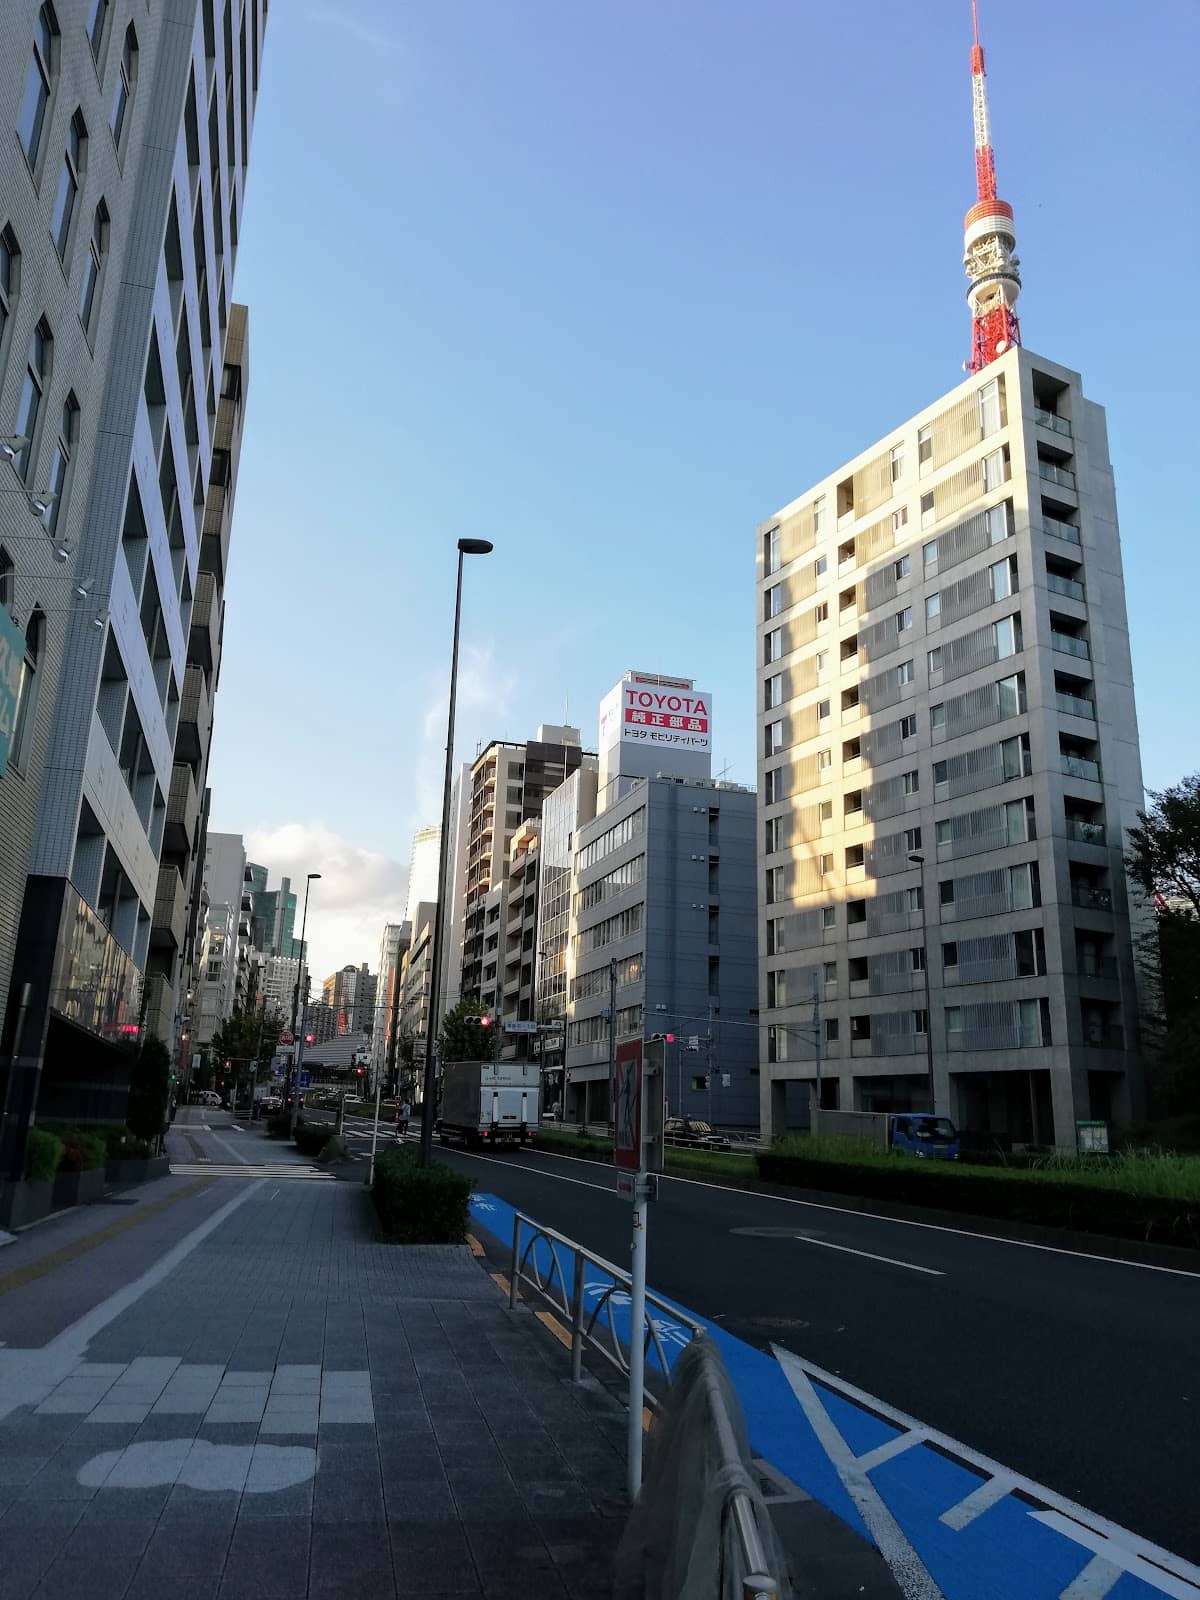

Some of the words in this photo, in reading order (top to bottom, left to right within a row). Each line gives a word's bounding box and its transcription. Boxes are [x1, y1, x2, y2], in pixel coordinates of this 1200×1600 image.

[626, 690, 707, 715] TOYOTA
[631, 711, 702, 730] 純正部品
[625, 728, 647, 739] トヨタ
